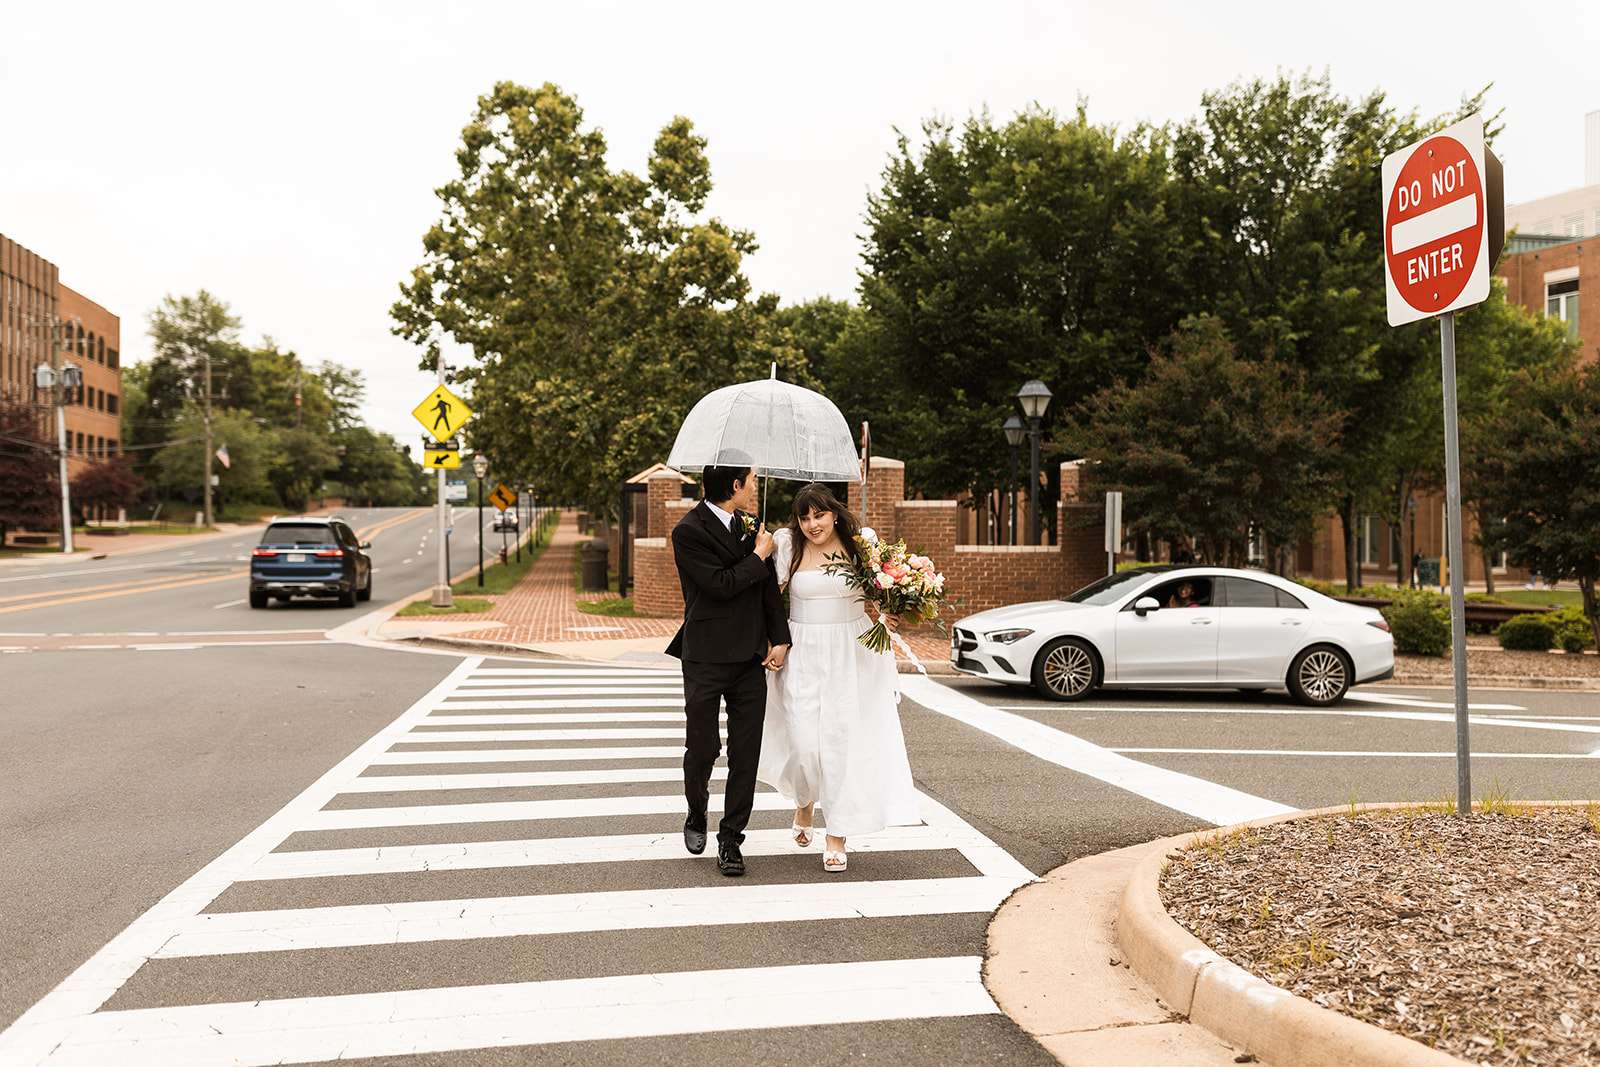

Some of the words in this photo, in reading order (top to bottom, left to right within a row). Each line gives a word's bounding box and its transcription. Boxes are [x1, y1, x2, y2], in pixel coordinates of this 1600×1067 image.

[1398, 180, 1421, 212] DO
[1432, 159, 1467, 198] NOT
[1407, 243, 1463, 285] ENTER
